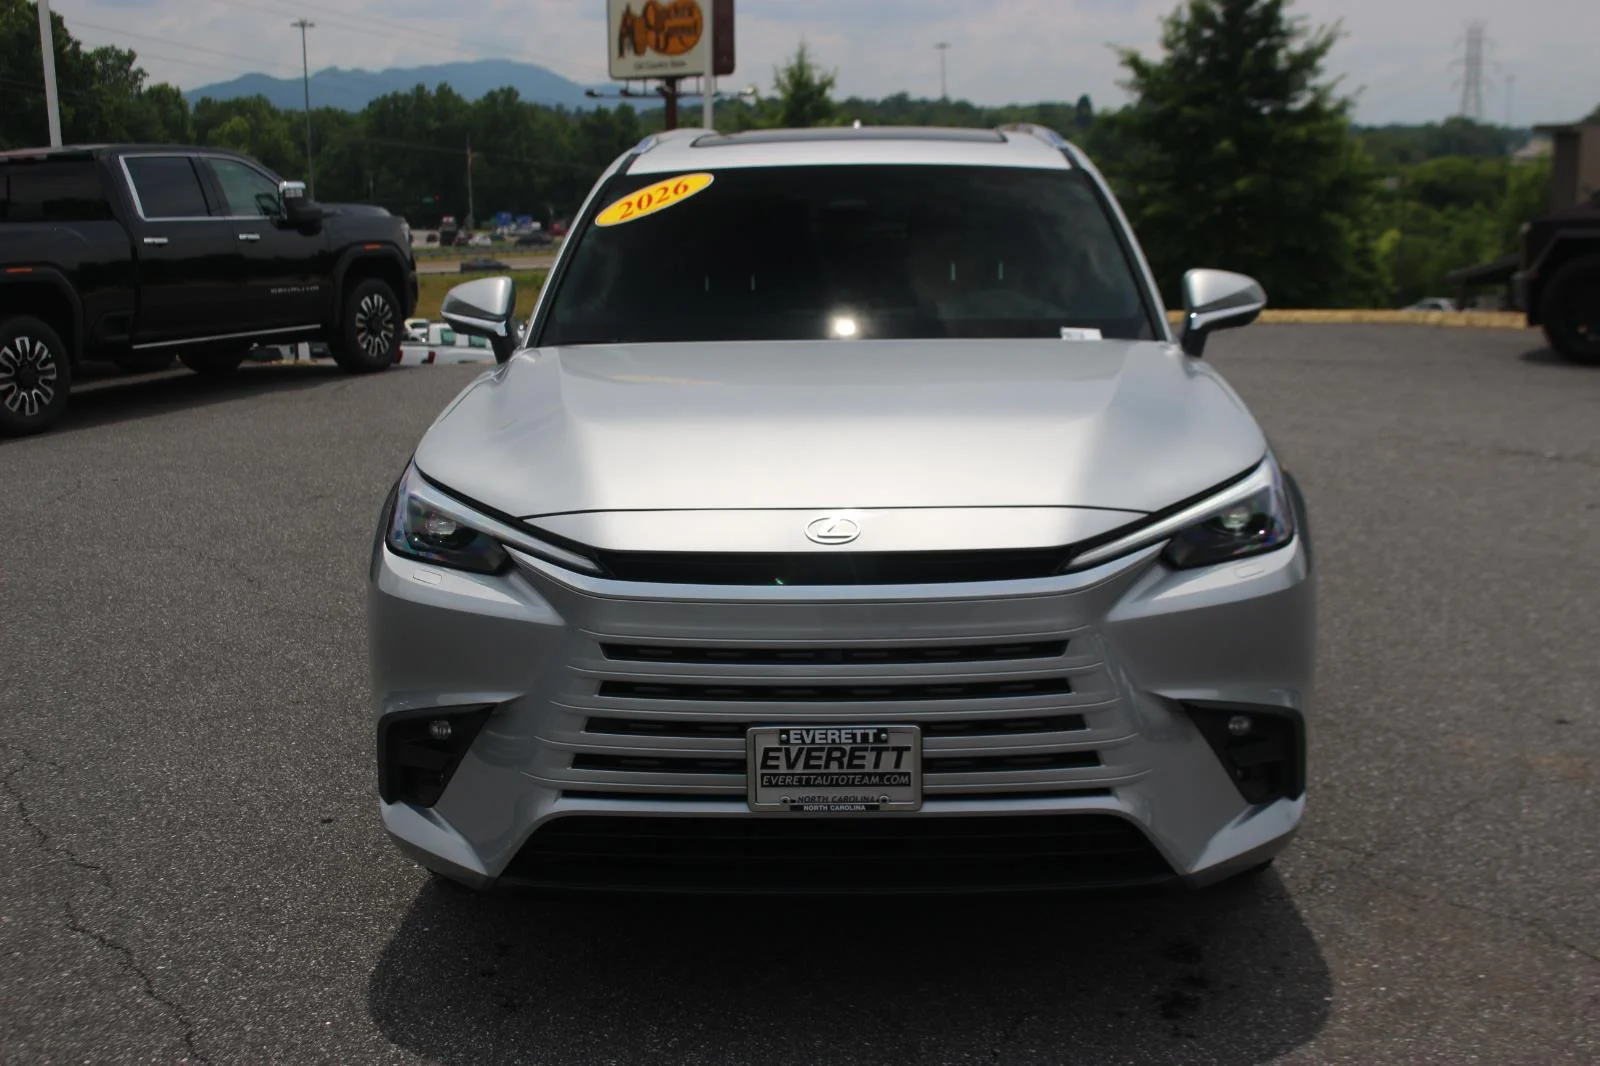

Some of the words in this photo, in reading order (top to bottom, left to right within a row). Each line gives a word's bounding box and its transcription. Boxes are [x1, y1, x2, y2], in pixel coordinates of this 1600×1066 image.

[619, 180, 689, 220] 2026
[790, 730, 877, 743] EVERETT
[760, 746, 912, 770] EVERETT
[763, 775, 909, 785] EVERETTAUTOTEAM.COM
[798, 795, 828, 803] NORTH
